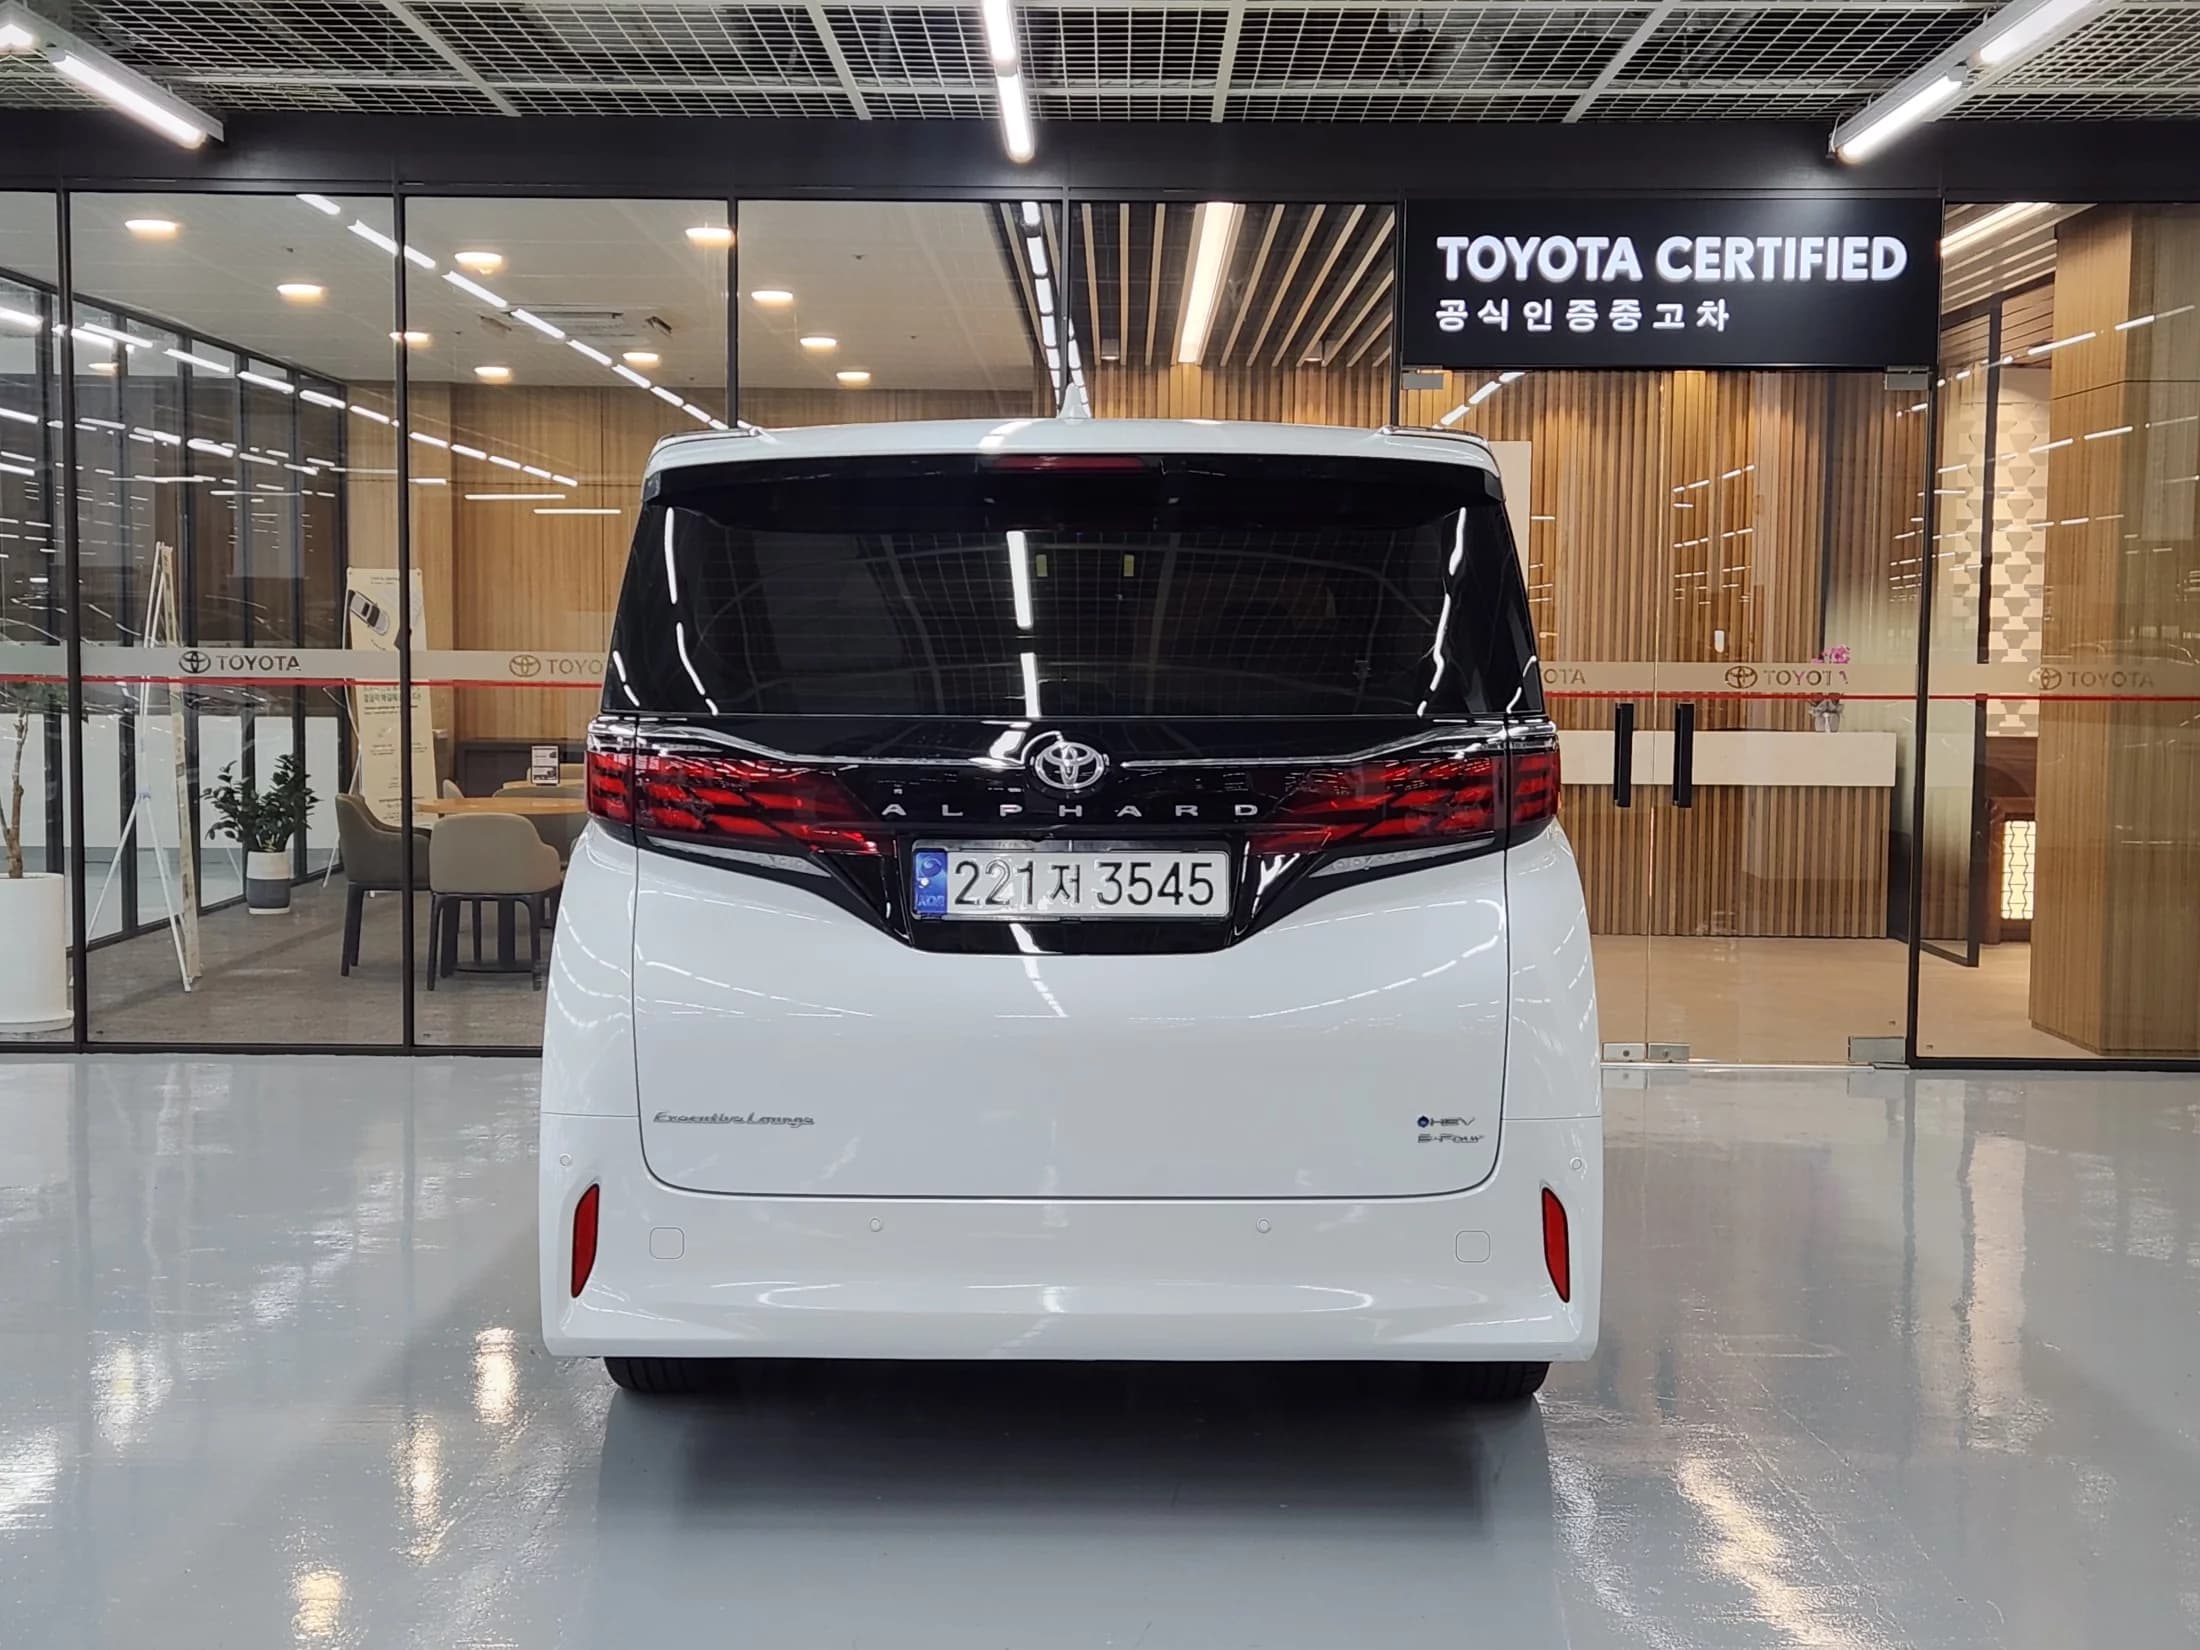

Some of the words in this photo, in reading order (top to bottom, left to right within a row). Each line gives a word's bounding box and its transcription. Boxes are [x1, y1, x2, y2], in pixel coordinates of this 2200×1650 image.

[1436, 235, 1643, 282] TOYOTA
[1656, 235, 1908, 282] CERTIFIED
[215, 654, 301, 671] TOYOTA
[546, 658, 603, 675] TOYO
[1543, 668, 1586, 684] OTA
[2067, 671, 2154, 688] TOYOTA
[881, 803, 1259, 817] ALPHARD
